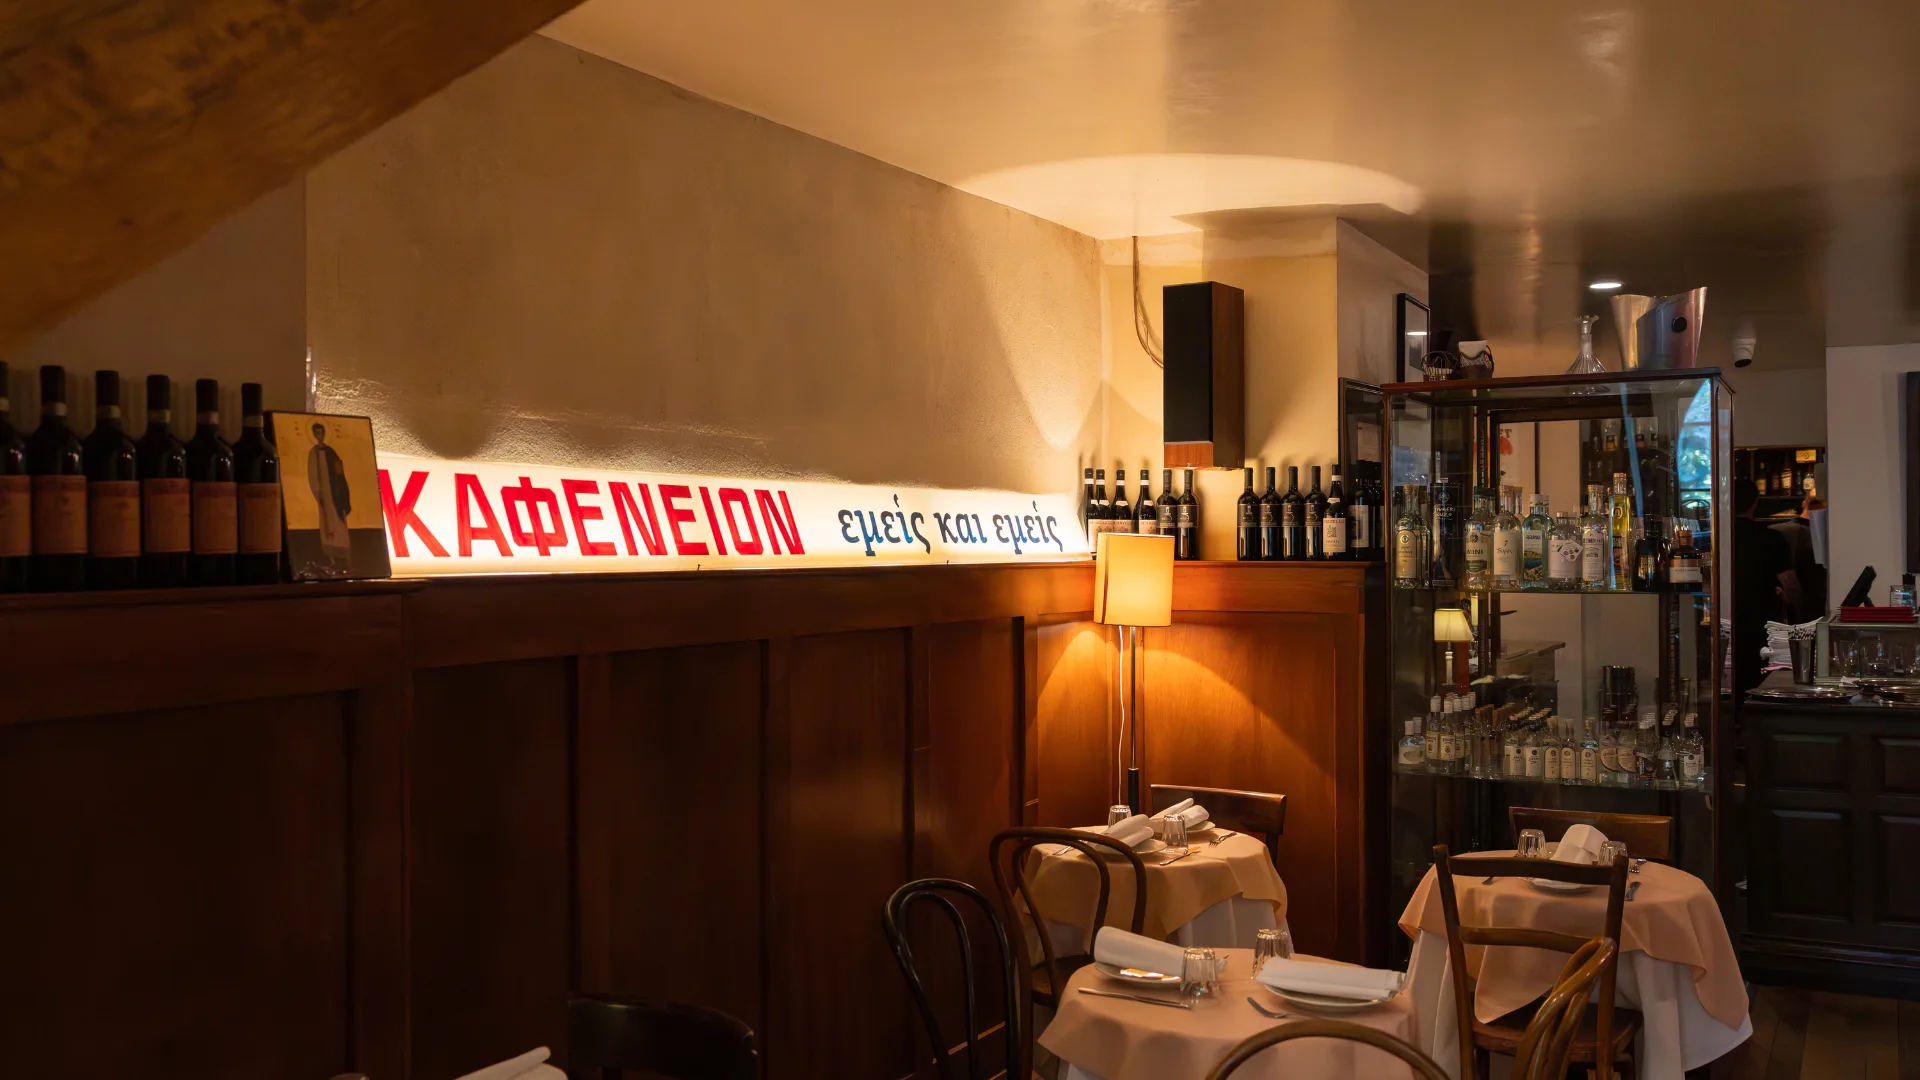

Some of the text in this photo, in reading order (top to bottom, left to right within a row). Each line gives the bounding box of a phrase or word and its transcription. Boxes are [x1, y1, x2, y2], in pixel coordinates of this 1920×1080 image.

[378, 468, 1063, 557] ΚΑΦΕΝΕΙΟΝ εμείς και εμείς
